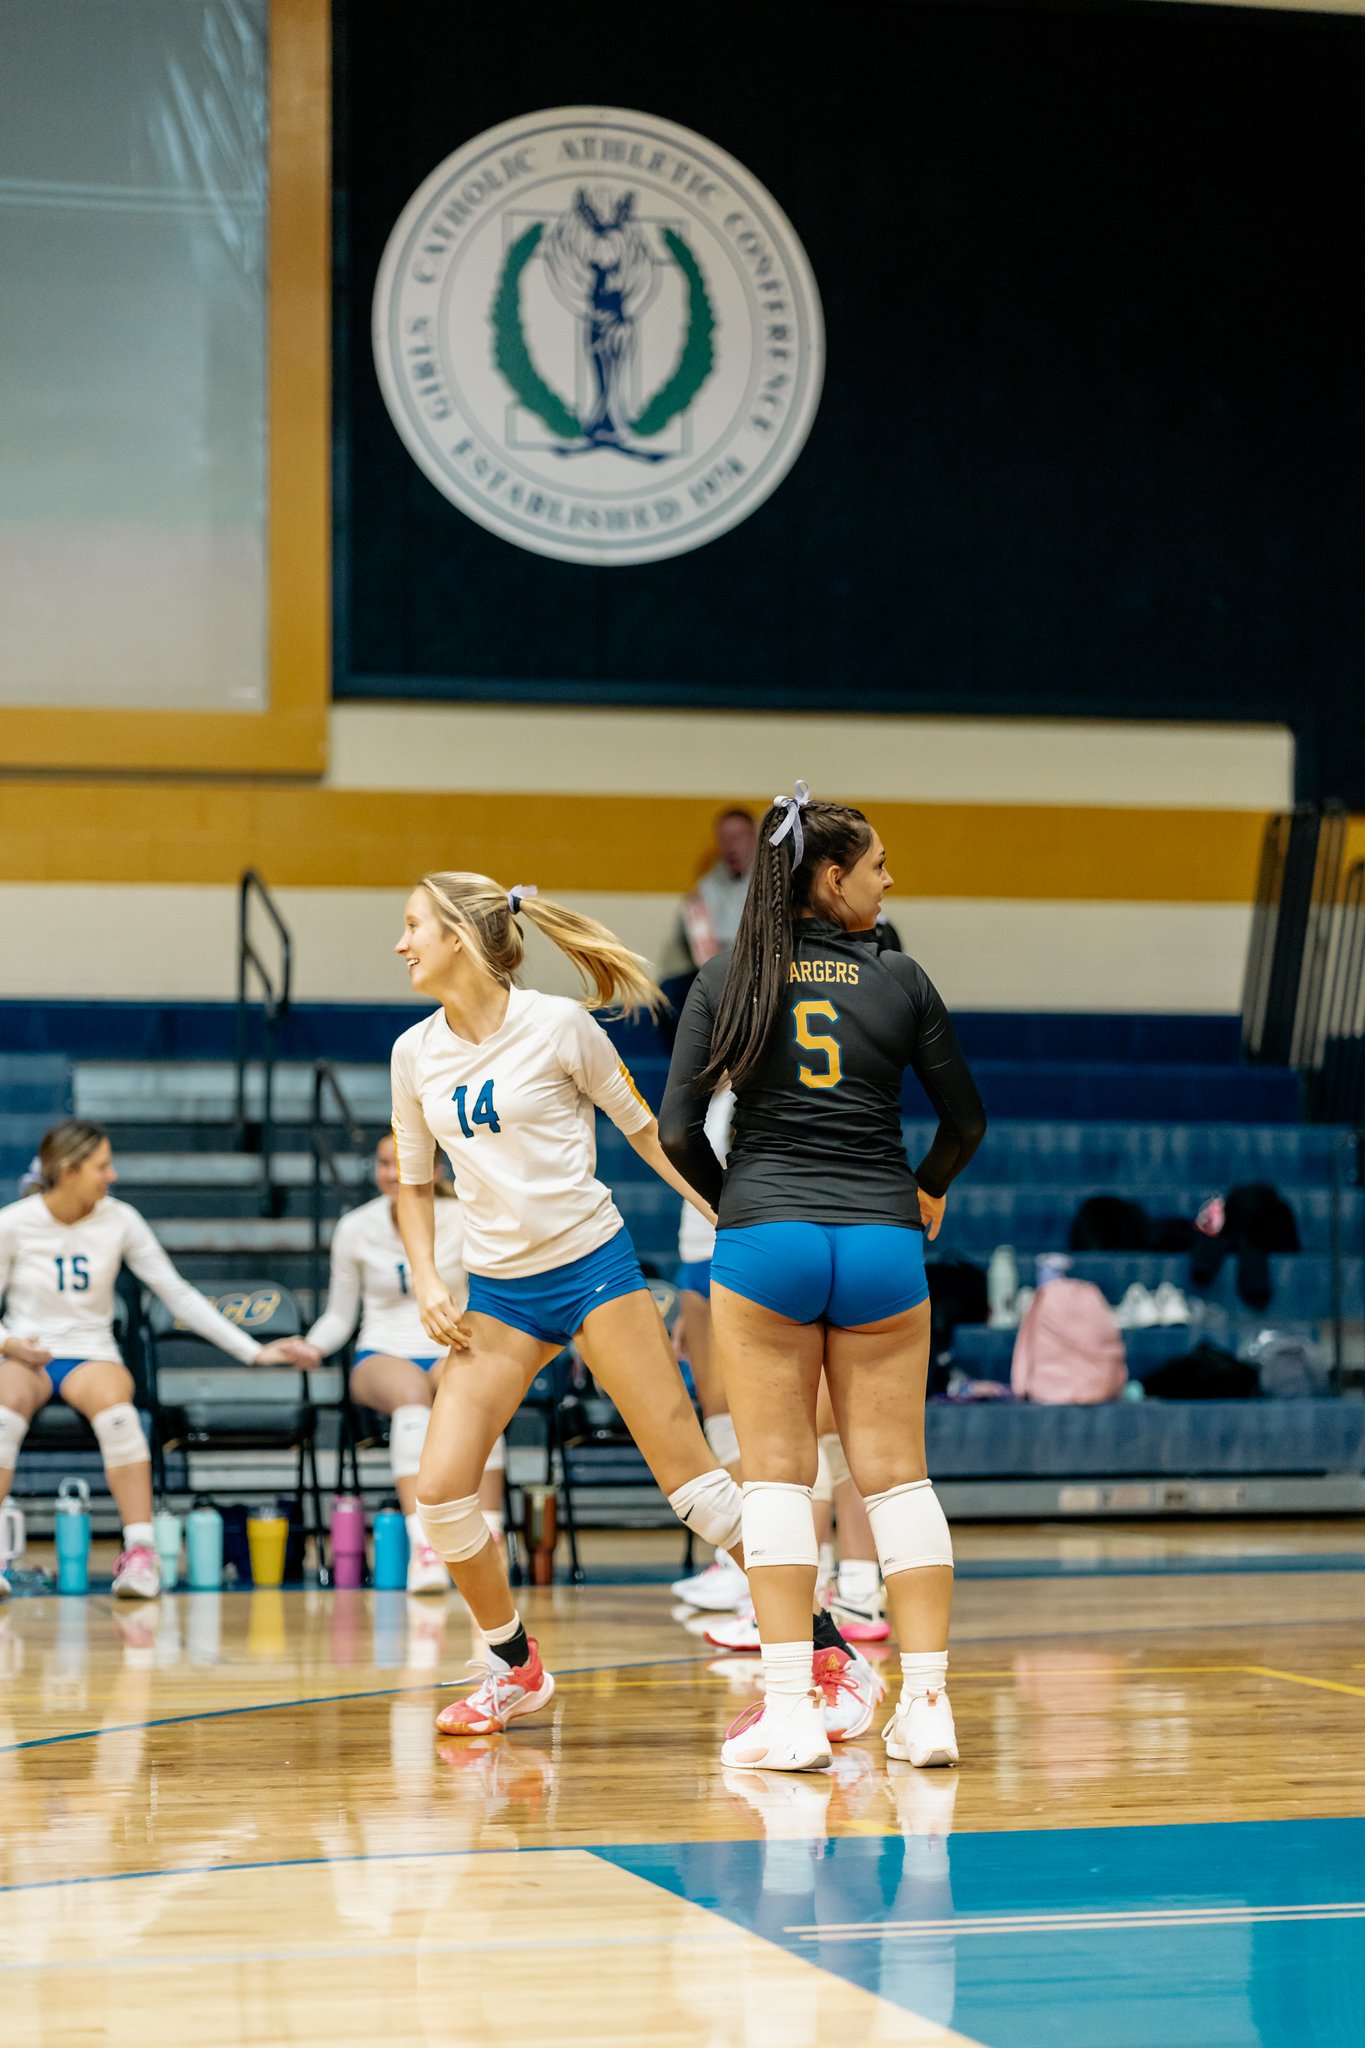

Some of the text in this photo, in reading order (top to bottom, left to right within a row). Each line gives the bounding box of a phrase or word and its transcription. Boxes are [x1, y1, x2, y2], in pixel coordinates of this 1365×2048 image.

[406, 135, 794, 434] GIRLS CATHOLIC ATHLETIC CONFERENCE
[452, 438, 682, 530] ESTABLISHED
[787, 960, 860, 985] ARGERS
[791, 998, 845, 1090] 5
[450, 1078, 501, 1139] 14
[55, 1255, 90, 1292] 15
[395, 1262, 409, 1296] 1
